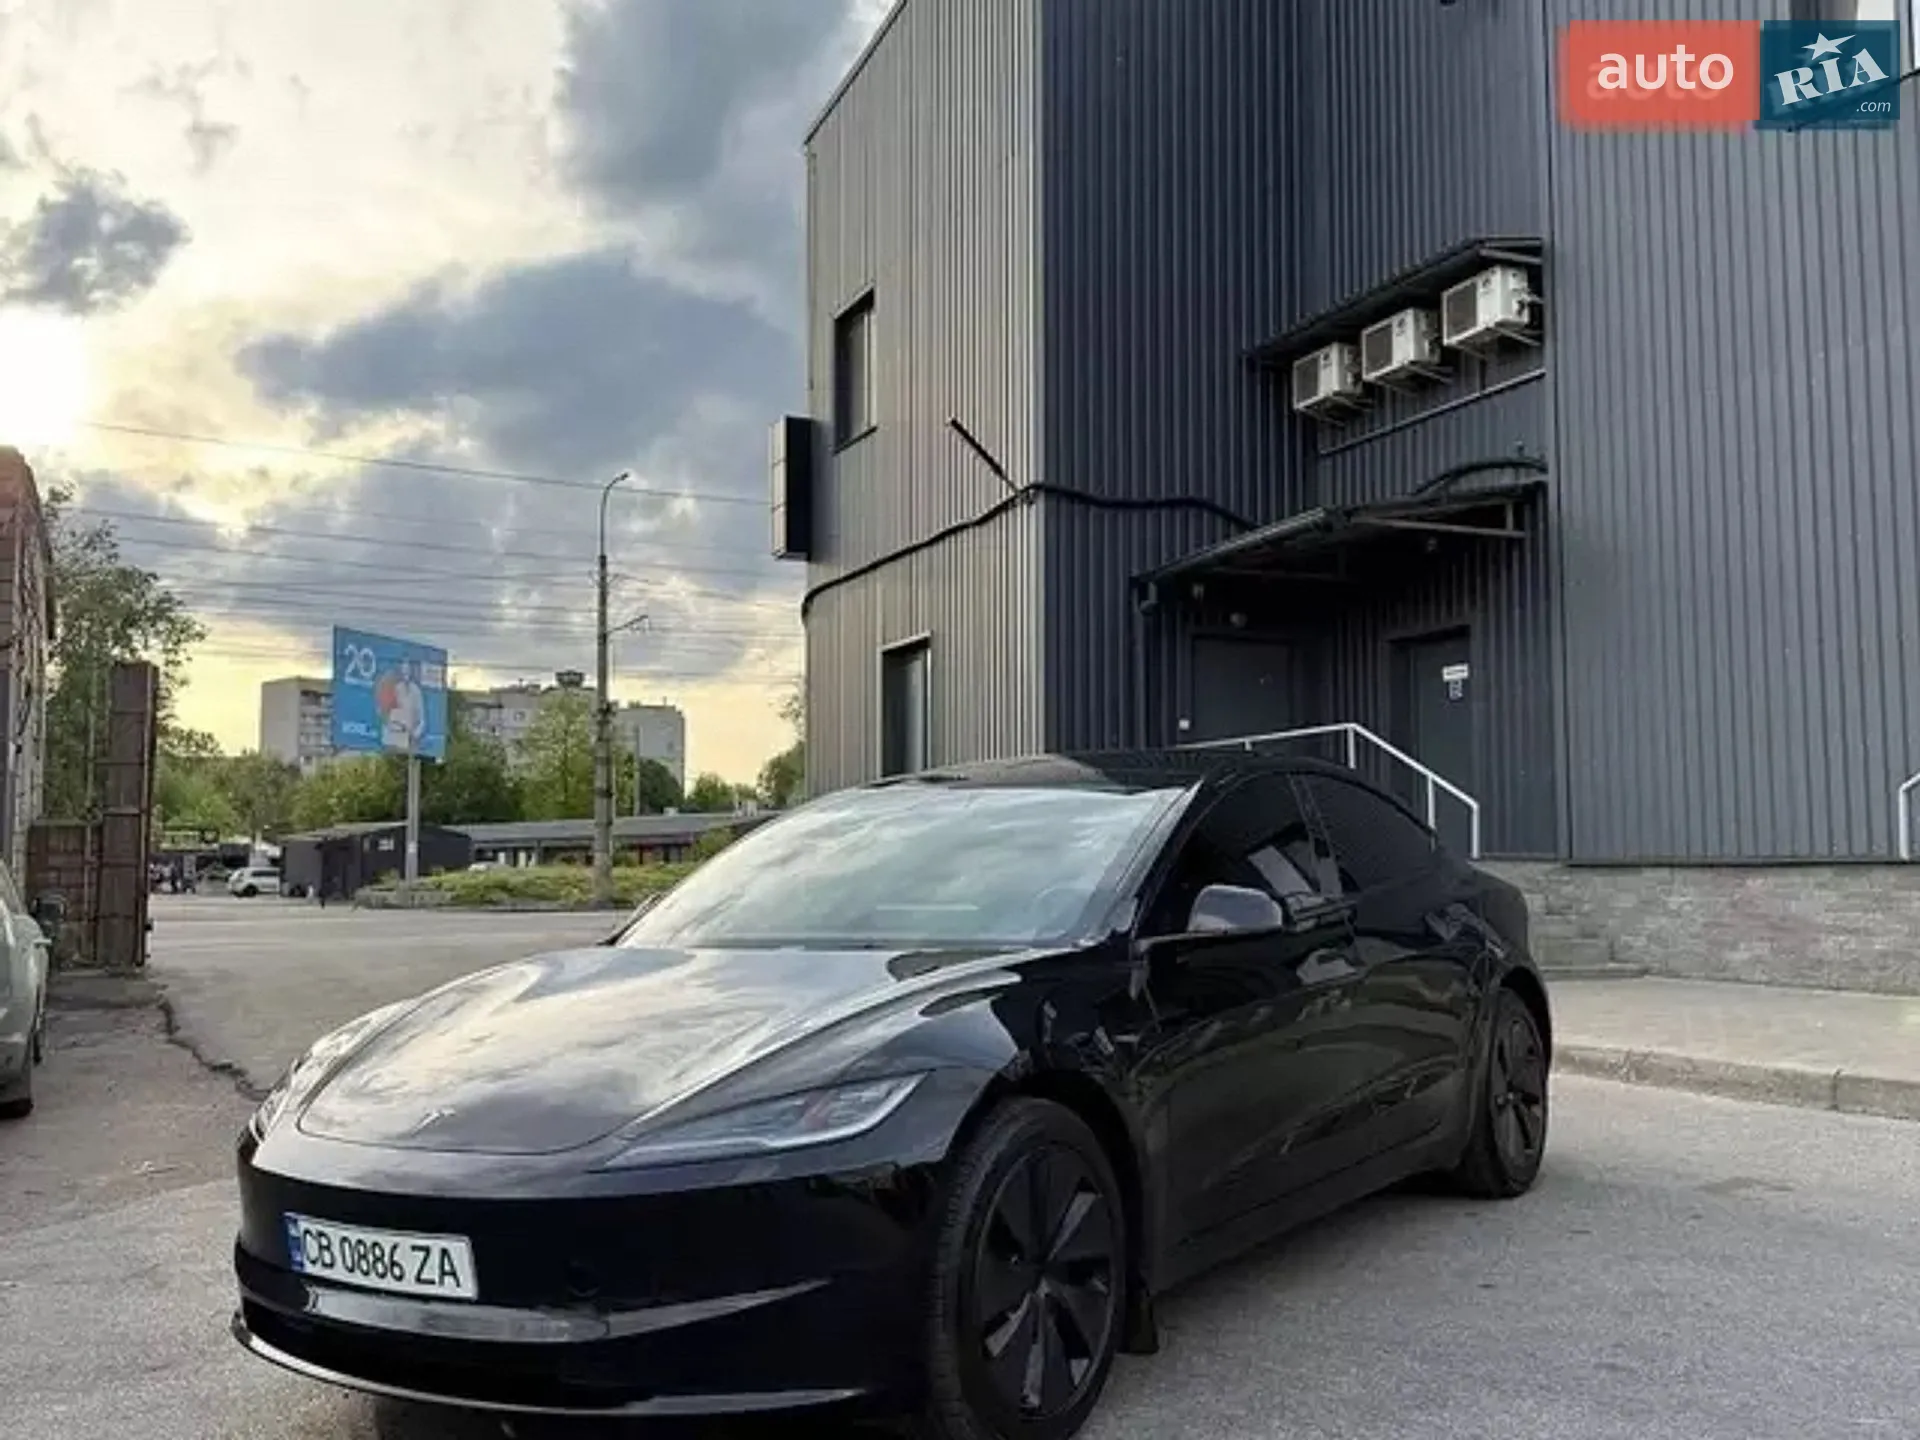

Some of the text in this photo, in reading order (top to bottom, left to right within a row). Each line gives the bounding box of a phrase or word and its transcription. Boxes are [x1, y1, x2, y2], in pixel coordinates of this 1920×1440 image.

[344, 644, 376, 682] 20
[303, 1228, 461, 1288] CB 0886 ZA
